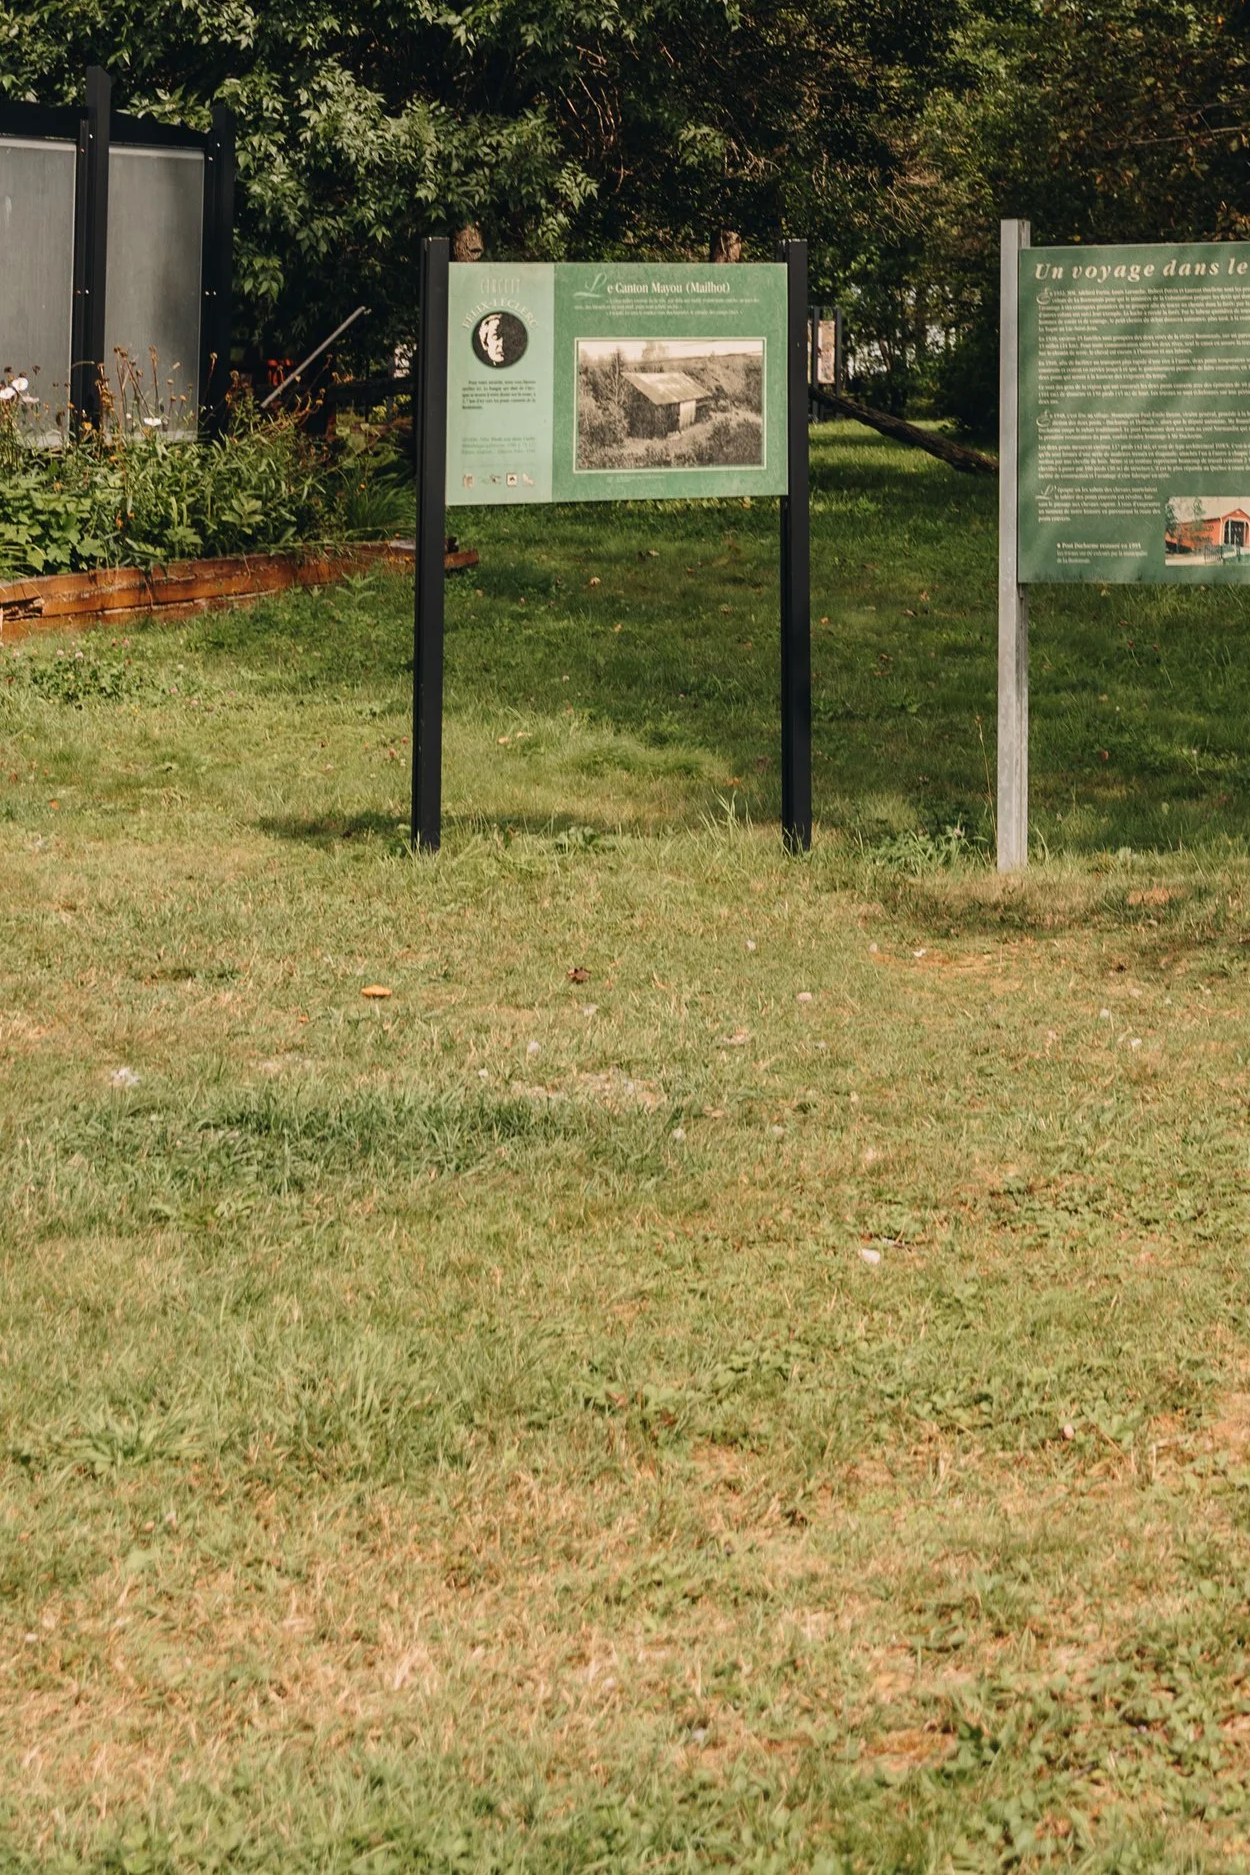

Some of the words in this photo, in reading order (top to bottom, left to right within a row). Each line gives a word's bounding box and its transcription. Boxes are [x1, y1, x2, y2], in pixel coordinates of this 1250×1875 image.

[1034, 263, 1064, 280] Un
[1071, 264, 1156, 283] voyage
[1162, 259, 1219, 278] dans
[1227, 258, 1249, 275] le
[616, 281, 649, 295] Canton
[651, 281, 683, 297] Mayou
[685, 280, 731, 296] (Mailhot)
